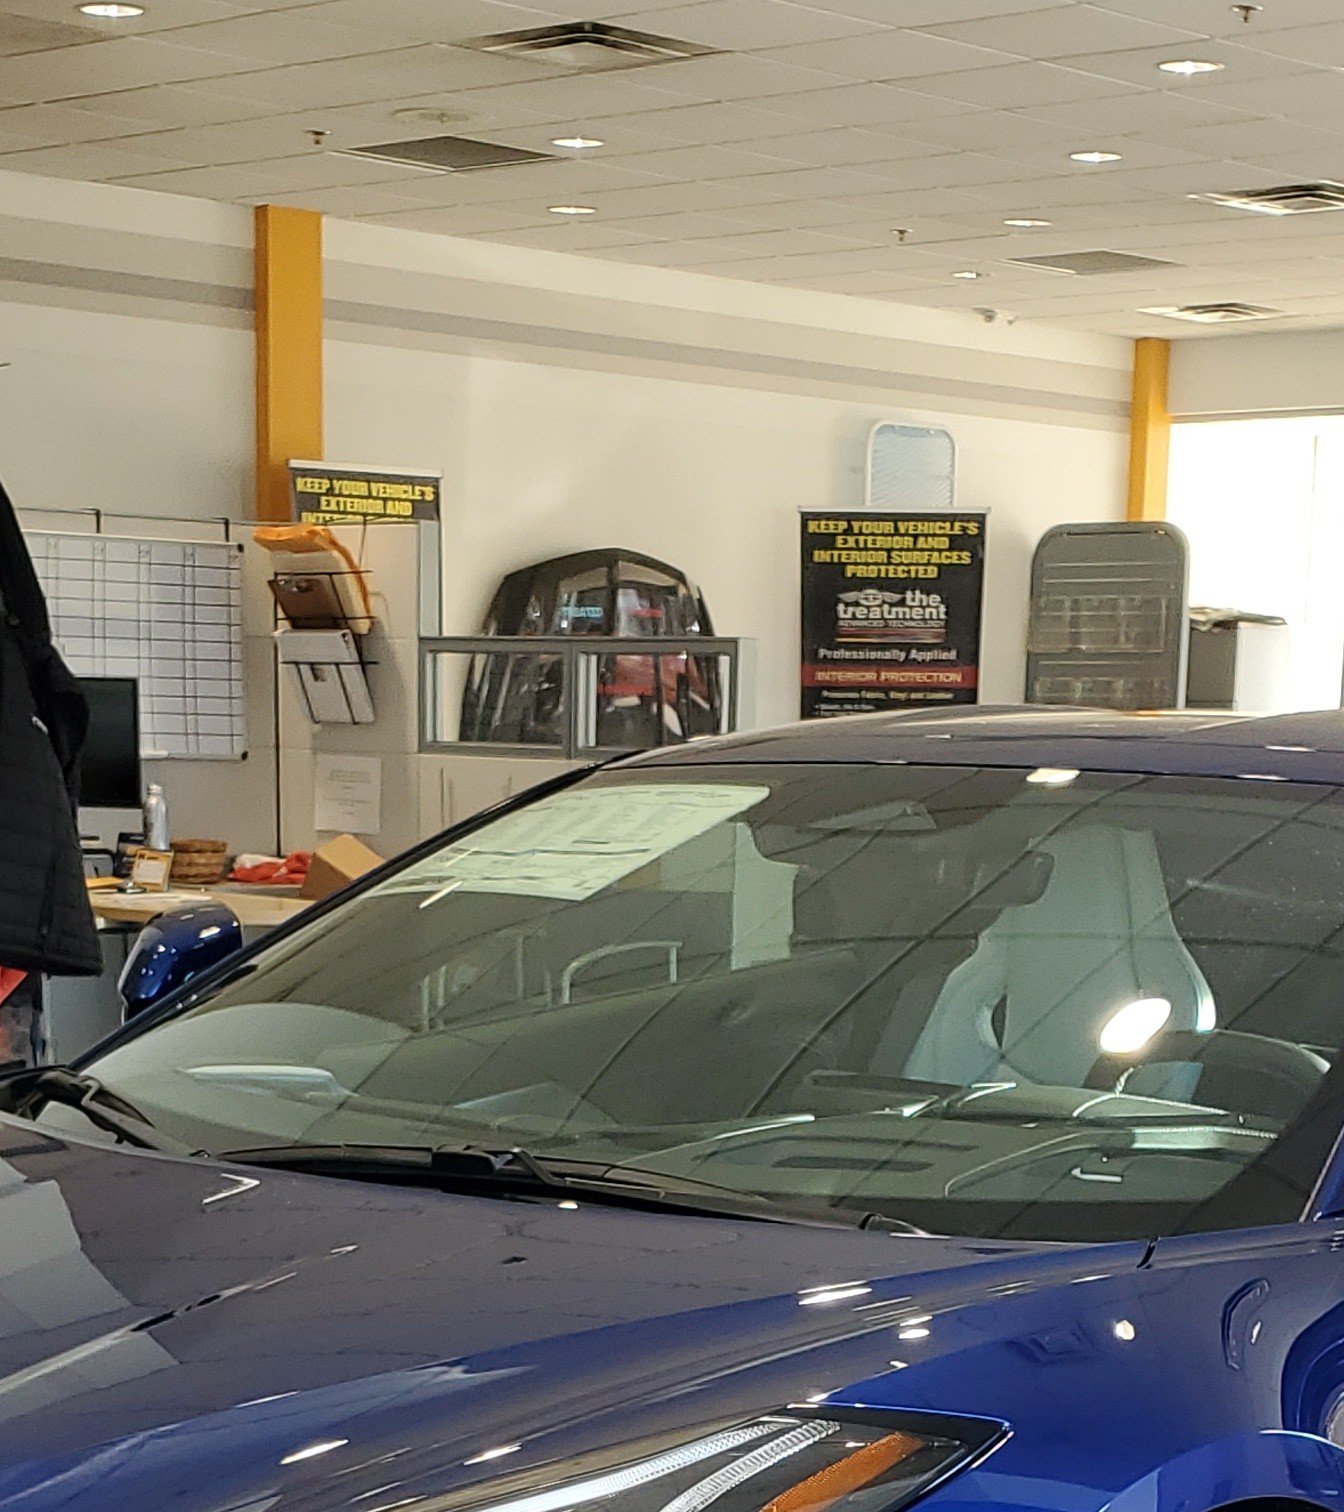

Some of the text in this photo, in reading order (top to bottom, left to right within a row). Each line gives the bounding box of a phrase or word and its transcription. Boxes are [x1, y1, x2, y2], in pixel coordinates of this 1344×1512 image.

[296, 477, 435, 501] KEEP YOUR VEHICLE'S
[320, 497, 413, 516] EXTERIOR AND
[807, 520, 981, 535] KEEP YOUR VEHICLE'S
[835, 535, 950, 549] EXTERIOR AND
[812, 550, 972, 564] INTERIOR SURFACES
[844, 564, 939, 578] PROTECTED
[905, 589, 942, 607] the
[836, 602, 948, 620] treatment
[818, 648, 957, 662] Professionally Applied
[815, 670, 962, 683] INTERIOR PROTECTION
